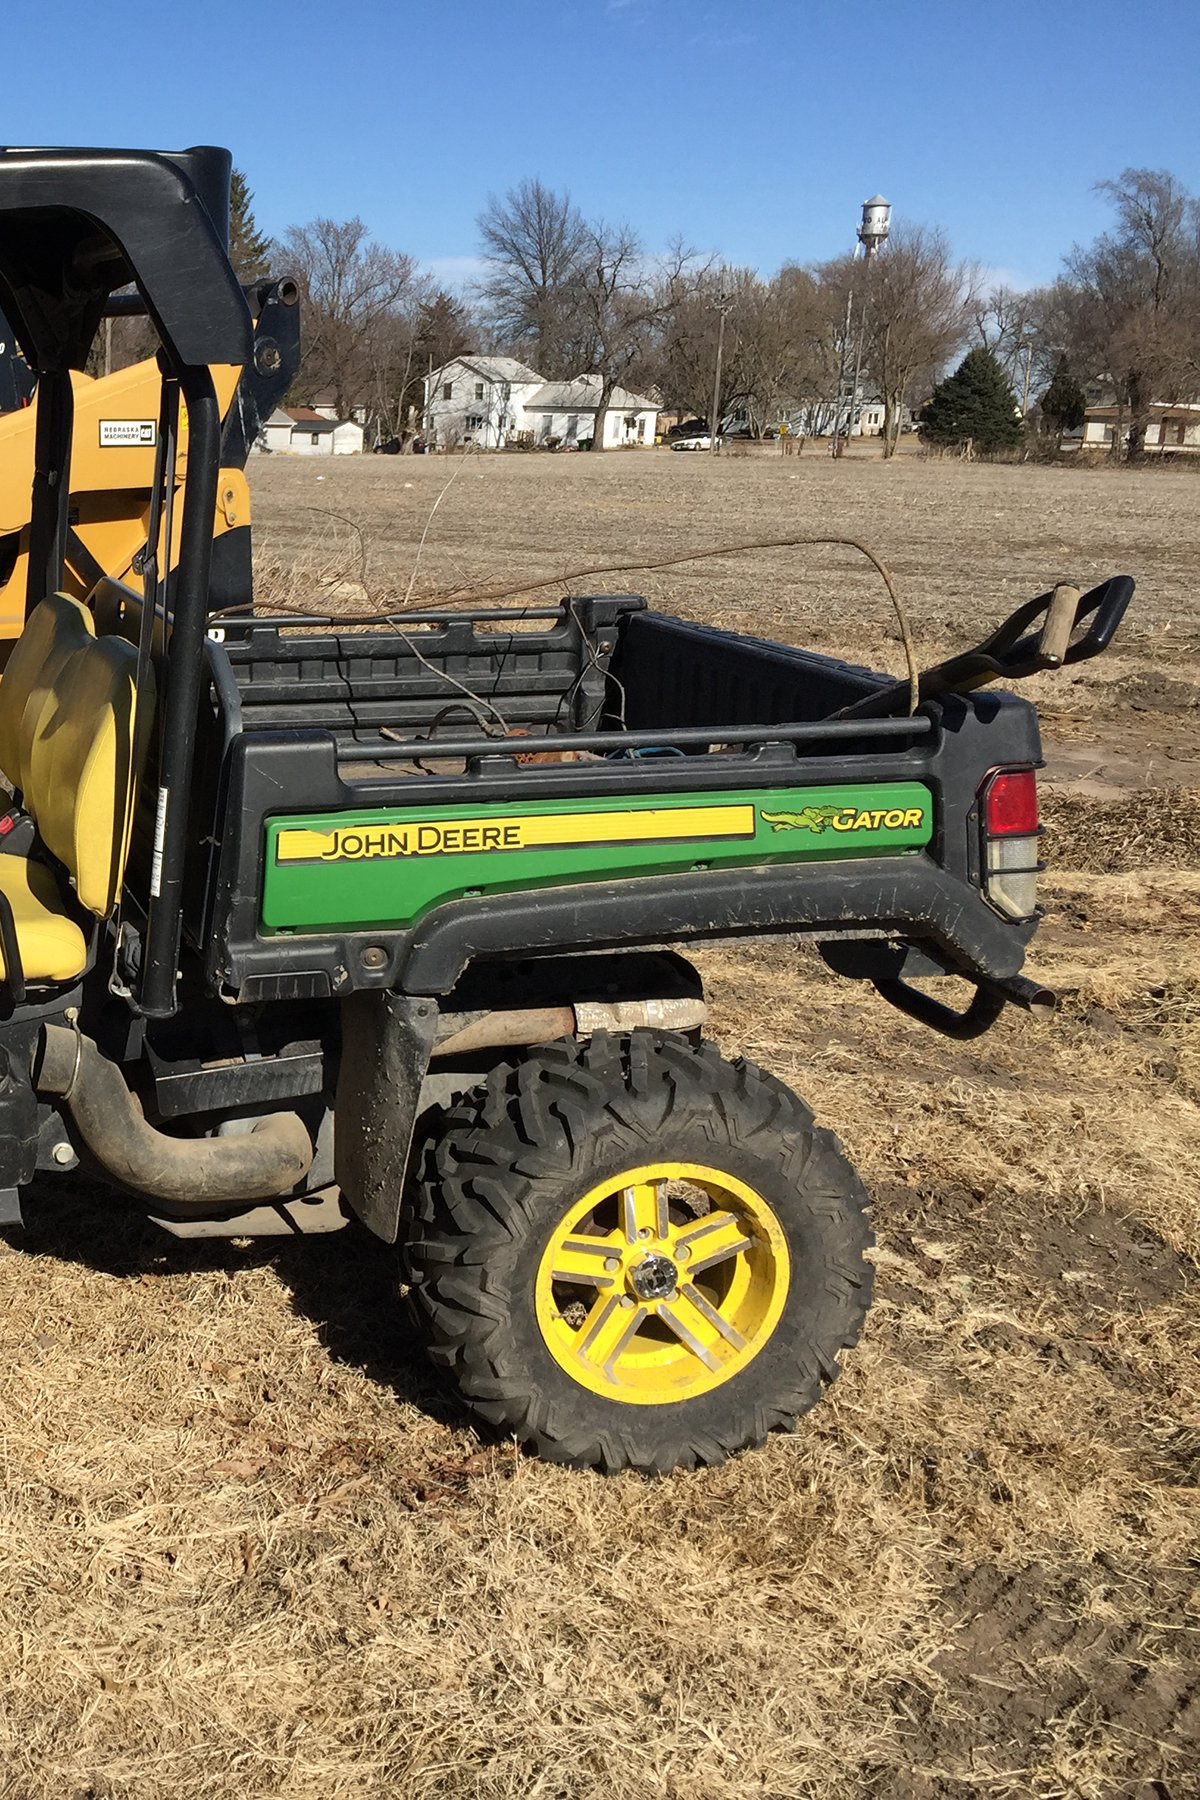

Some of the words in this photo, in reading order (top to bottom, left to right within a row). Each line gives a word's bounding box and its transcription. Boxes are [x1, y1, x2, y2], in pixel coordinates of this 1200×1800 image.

[831, 808, 924, 831] GATOR
[322, 831, 408, 857] JOHN
[417, 825, 521, 851] DEERE
